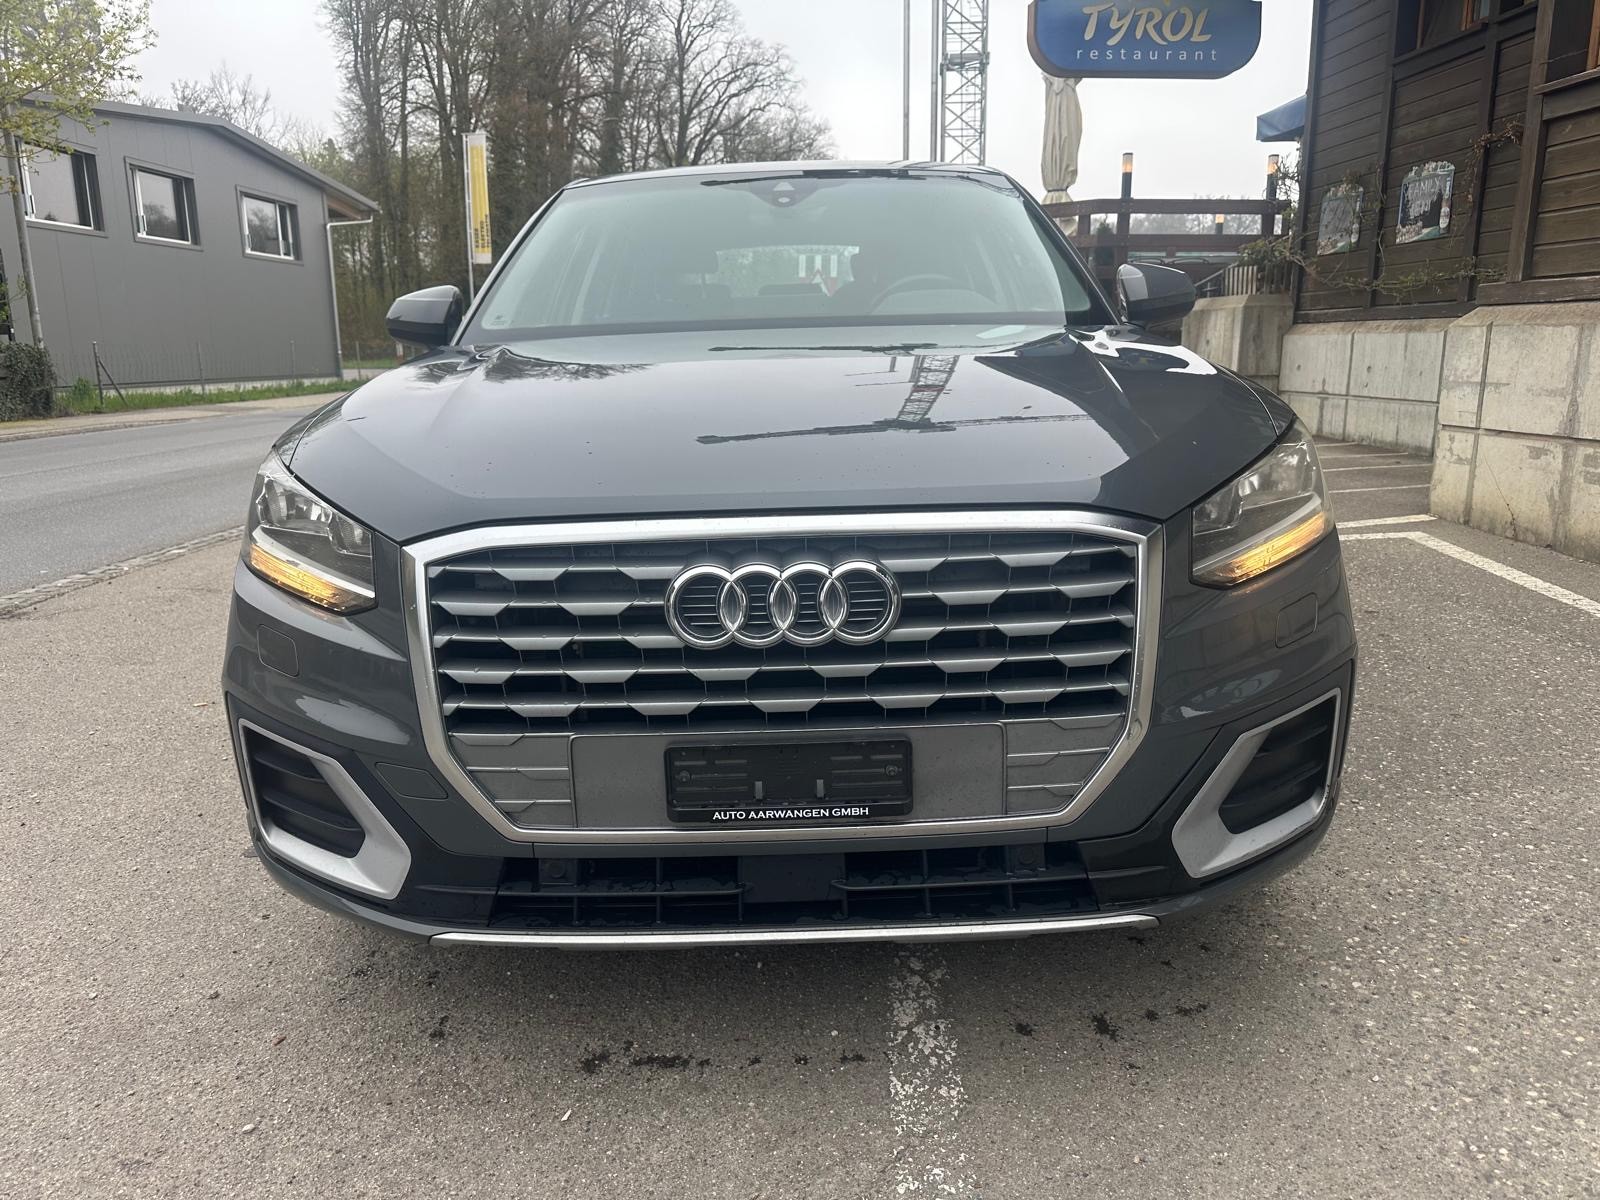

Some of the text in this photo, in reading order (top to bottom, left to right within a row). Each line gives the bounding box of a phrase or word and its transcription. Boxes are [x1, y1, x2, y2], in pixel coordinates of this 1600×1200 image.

[1082, 3, 1212, 46] TYROL
[1077, 48, 1217, 61] restaurant
[712, 806, 869, 821] AUTO AARWANGEN GMBH
